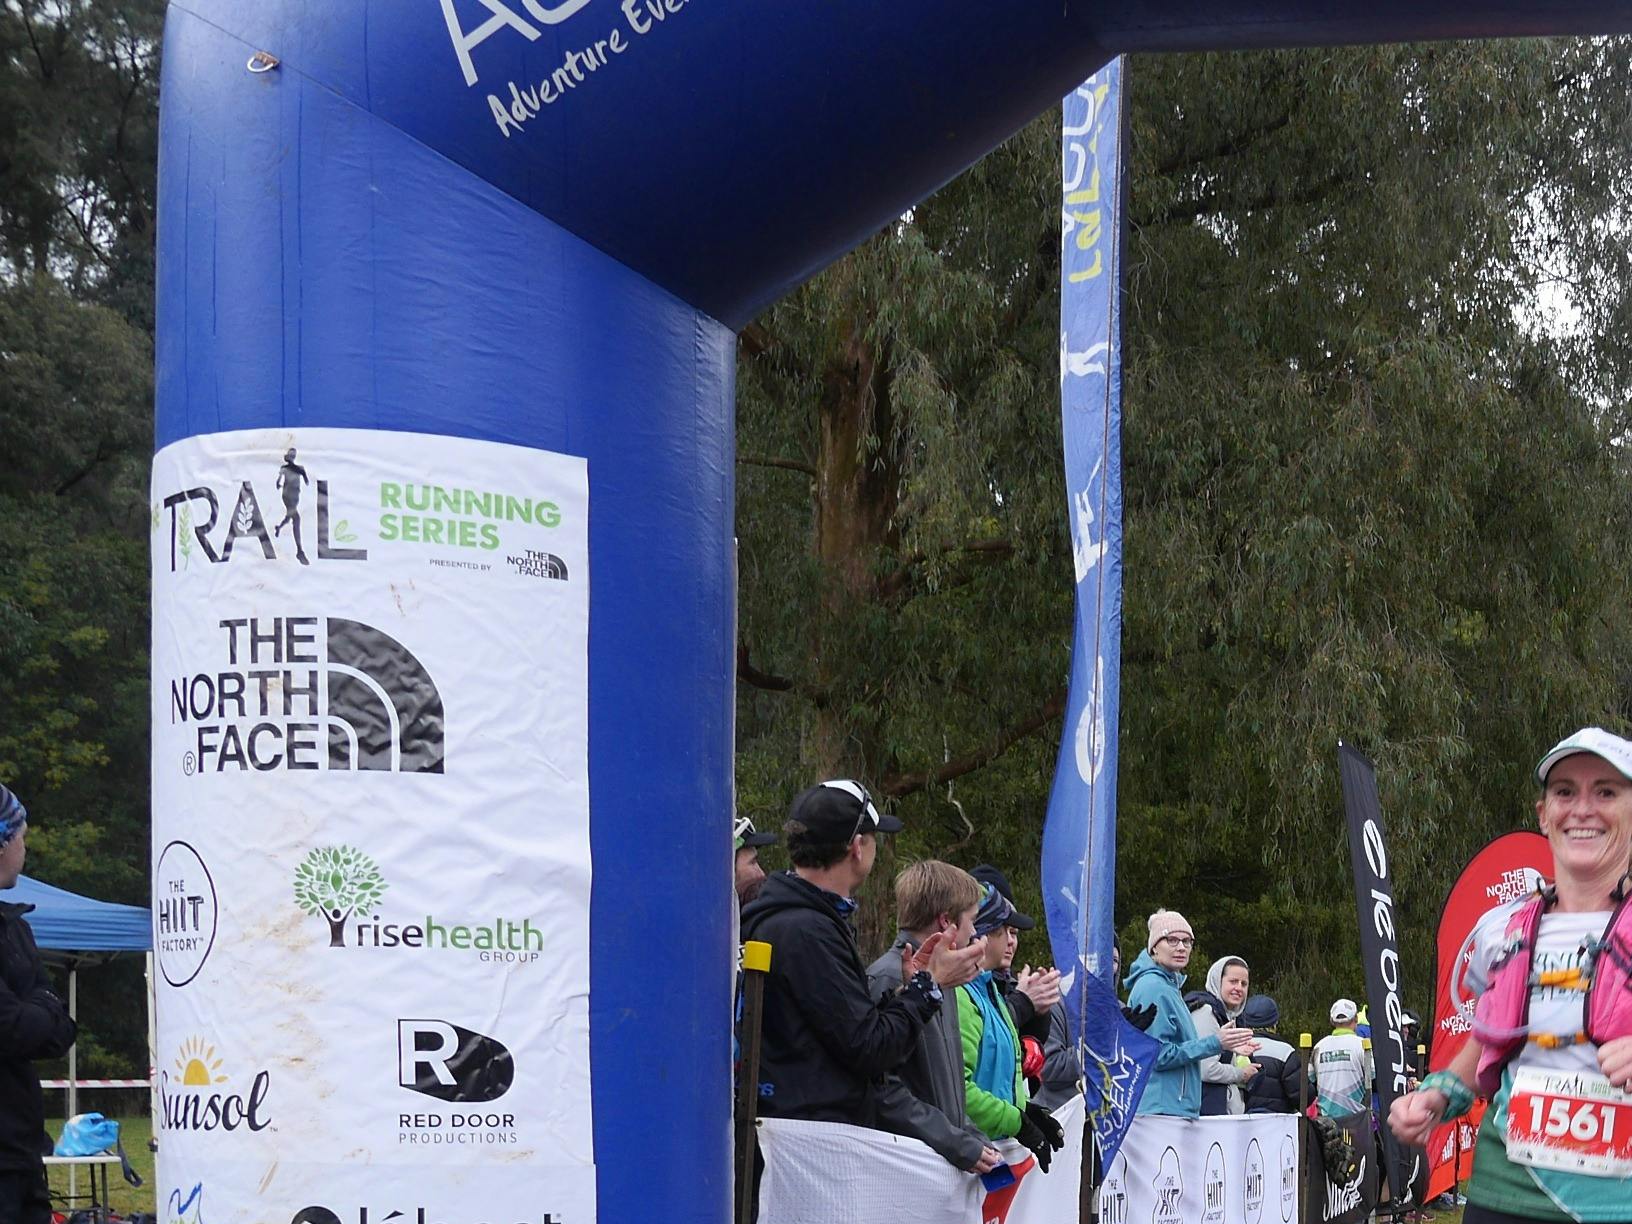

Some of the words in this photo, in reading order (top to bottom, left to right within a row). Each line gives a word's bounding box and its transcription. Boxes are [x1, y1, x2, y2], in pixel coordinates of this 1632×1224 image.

[487, 29, 628, 137] Adventure
[164, 448, 368, 572] TRAIL
[380, 482, 562, 528] RUNNING
[378, 513, 500, 550] SERIES
[507, 555, 548, 570] NORTH
[525, 549, 548, 561] THE
[429, 558, 479, 570] PRESENTED
[480, 563, 492, 571] BY
[518, 566, 548, 578] FACE
[219, 617, 318, 664] THE
[171, 671, 318, 724] NORTH
[198, 723, 319, 773] FACE
[1502, 868, 1524, 884] THE
[168, 880, 185, 893] THE
[1486, 878, 1526, 898] NORTH
[159, 895, 204, 934] HIIT
[162, 937, 197, 952] FACTORY
[480, 951, 539, 963] GROUP
[1451, 1020, 1472, 1035] FAC
[161, 1069, 272, 1132] Sunsol
[399, 1114, 442, 1128] RED
[451, 1114, 515, 1128] DOOR
[1529, 1095, 1617, 1144] 1561
[399, 1132, 518, 1144] PRODUCTIONS
